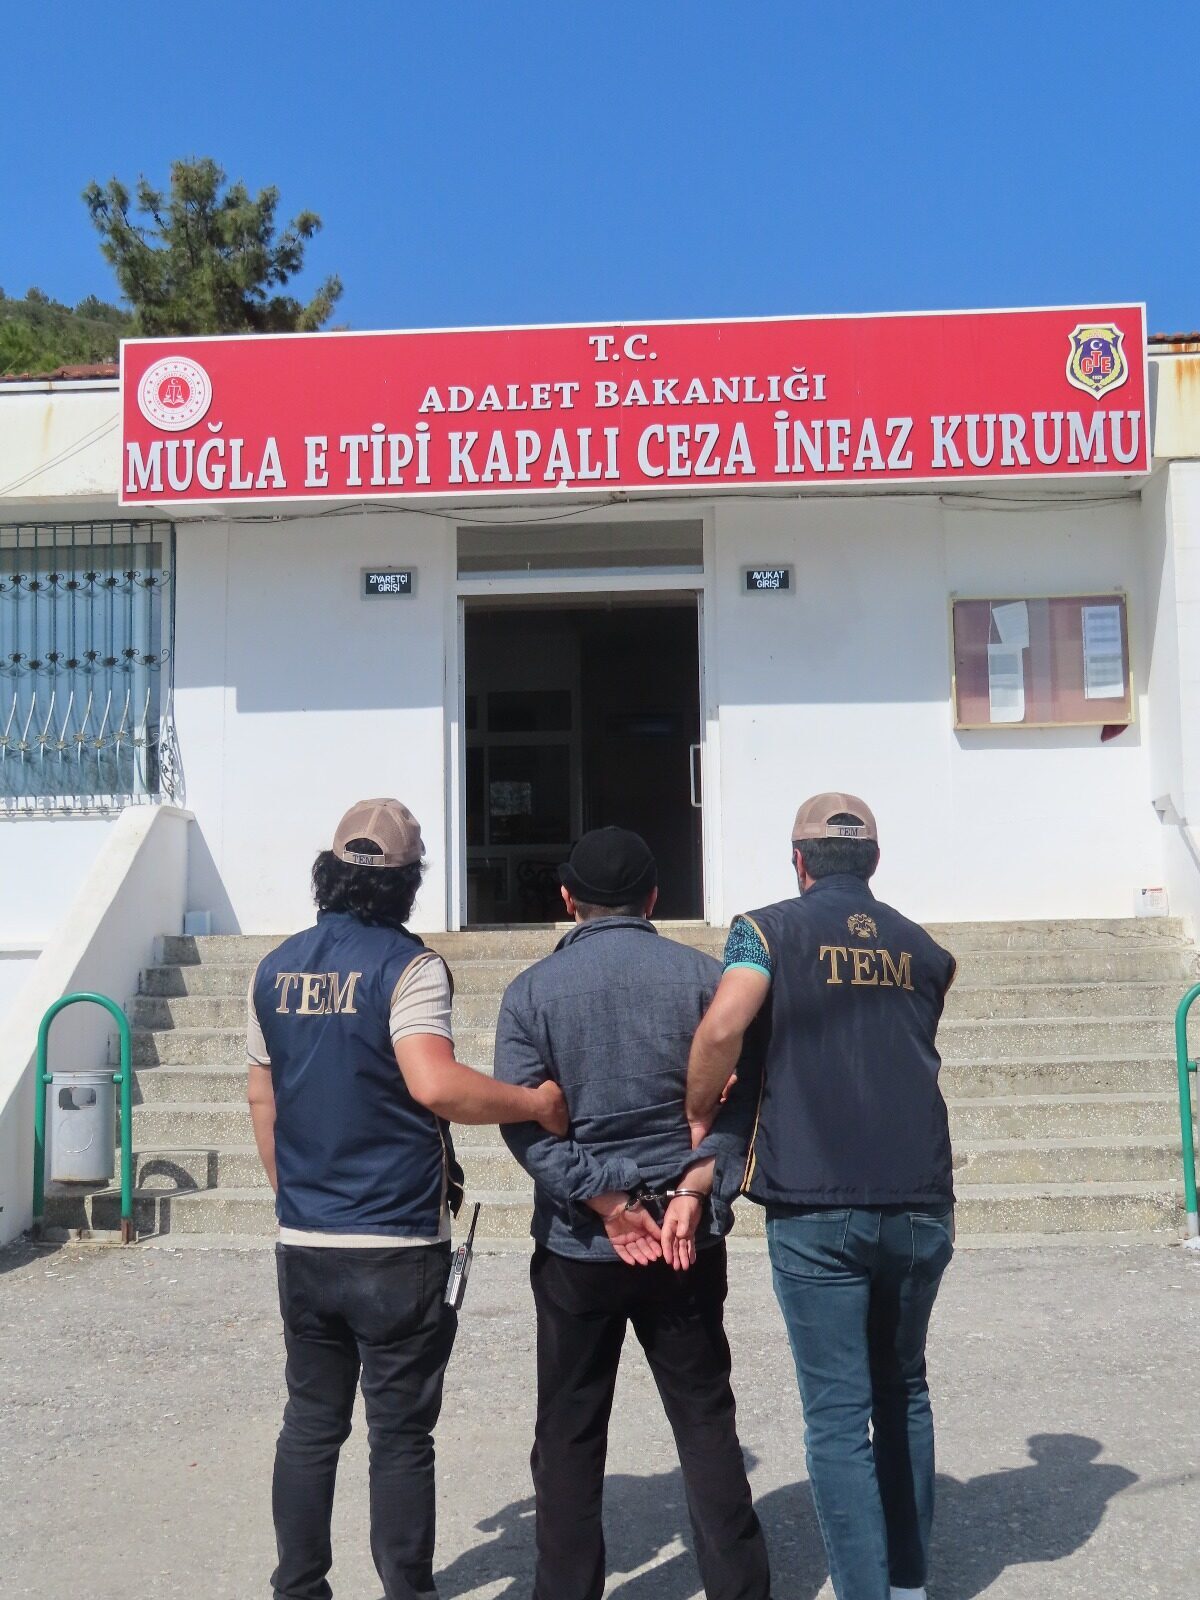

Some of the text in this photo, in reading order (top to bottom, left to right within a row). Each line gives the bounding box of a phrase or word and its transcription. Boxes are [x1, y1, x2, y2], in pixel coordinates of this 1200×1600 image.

[588, 334, 659, 362] T.C.
[418, 367, 827, 413] ADALET BAKANLIĞI
[126, 410, 1141, 493] MUĞLA E TİPİ KAPALI CEZA İNFAZ KURUMU
[369, 574, 408, 585] ZİYARETÇİ
[377, 583, 401, 593] GİRİŞİ
[752, 570, 785, 580] AVUKAT
[756, 579, 780, 590] GİRİŞİ
[819, 945, 915, 991] TEM
[274, 971, 363, 1015] TEM
